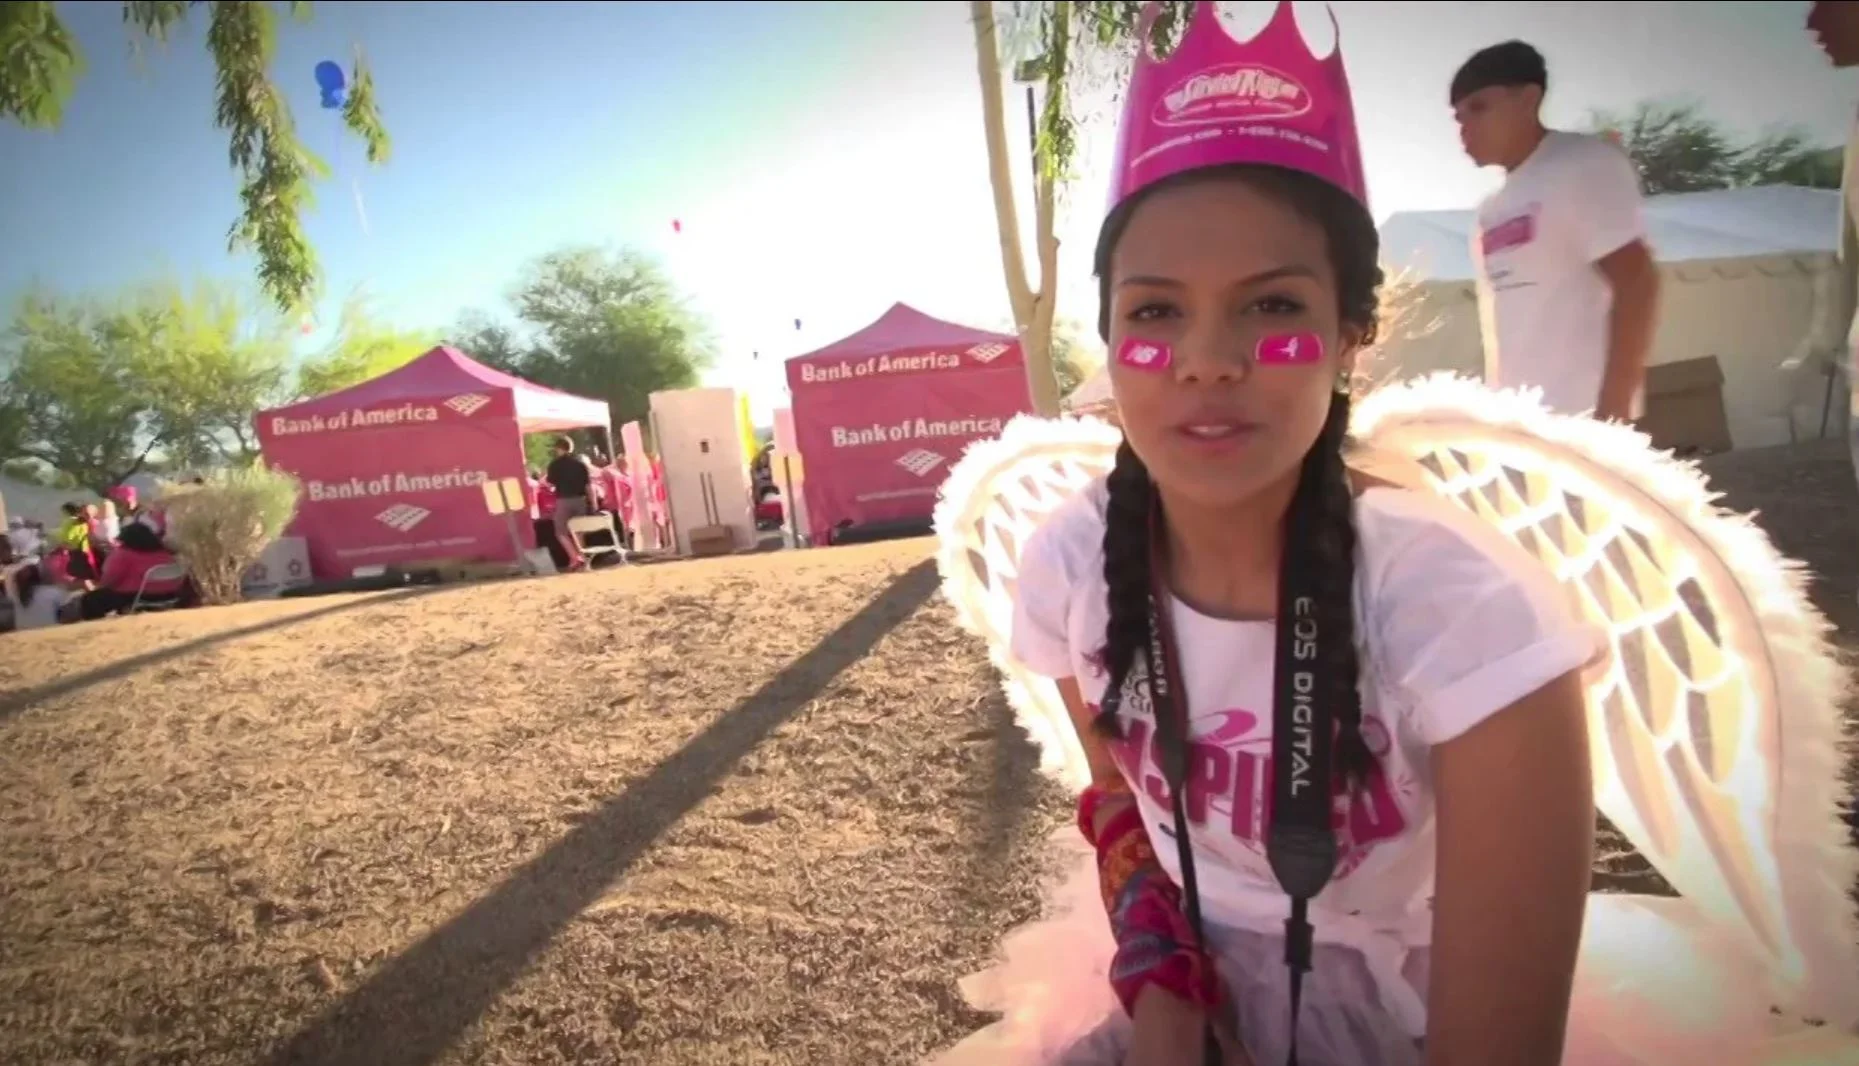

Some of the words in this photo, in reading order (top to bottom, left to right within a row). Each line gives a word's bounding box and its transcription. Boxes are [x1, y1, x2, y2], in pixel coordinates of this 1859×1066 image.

[801, 361, 853, 383] Bank
[856, 358, 874, 377] of
[878, 351, 961, 373] America
[271, 415, 325, 436] Bank
[328, 411, 348, 430] of
[352, 403, 439, 427] America
[831, 423, 887, 448] Bank
[889, 419, 912, 441] of
[914, 414, 1002, 439] America
[308, 477, 367, 501] Bank
[368, 474, 391, 496] of
[395, 466, 489, 493] America
[1294, 596, 1318, 661] EOS
[1291, 671, 1314, 798] DIGITAL
